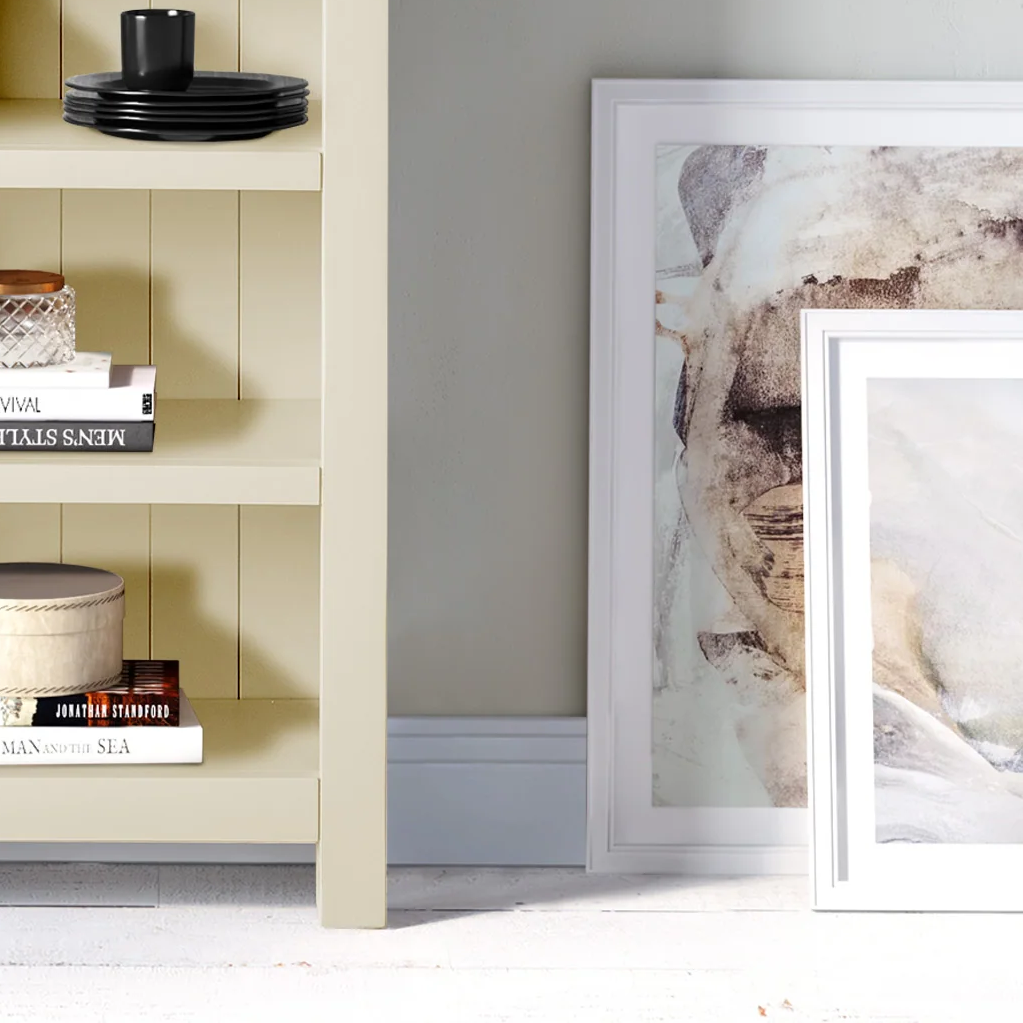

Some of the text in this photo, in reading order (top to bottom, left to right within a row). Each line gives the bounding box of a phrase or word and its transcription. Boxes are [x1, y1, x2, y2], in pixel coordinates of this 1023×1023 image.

[62, 428, 126, 446] MEN'S
[56, 703, 170, 718] JONATHAN STANDFORD
[1, 739, 41, 755] MAN
[42, 742, 68, 754] AND
[69, 742, 93, 754] THE
[97, 738, 130, 754] SEA
